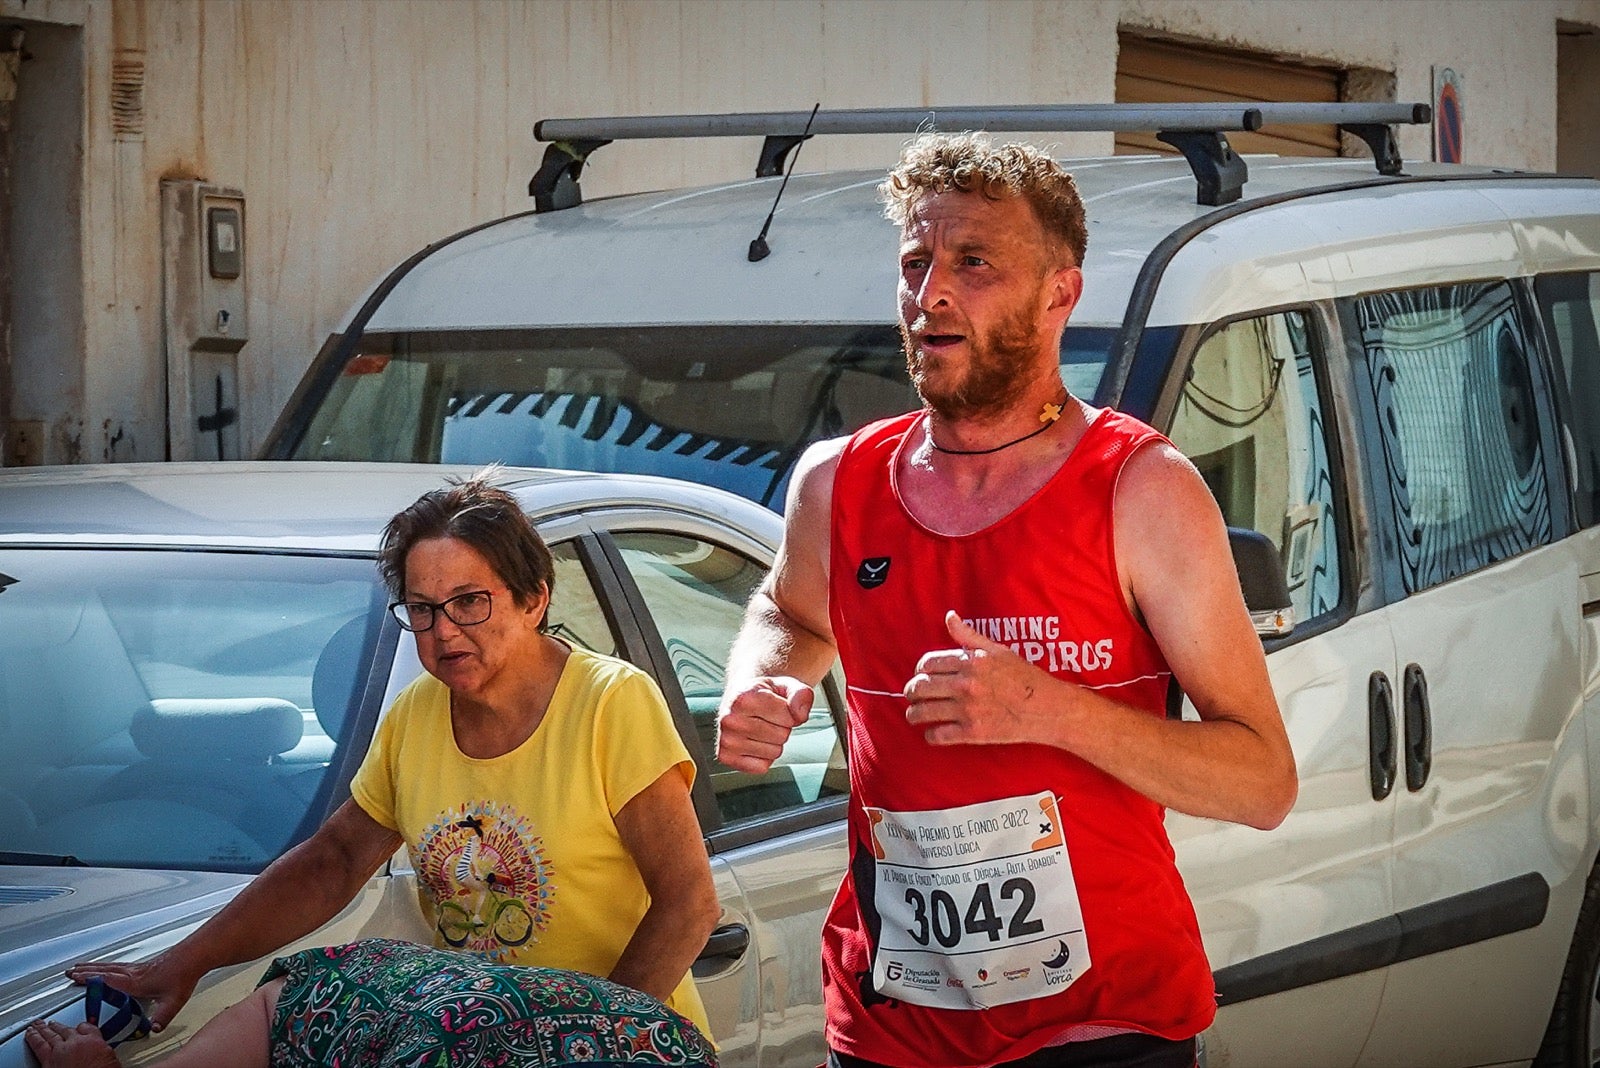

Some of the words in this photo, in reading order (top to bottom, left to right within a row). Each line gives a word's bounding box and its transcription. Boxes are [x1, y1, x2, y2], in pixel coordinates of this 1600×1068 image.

[1007, 638, 1113, 673] PIROS
[919, 825, 951, 842] PREMIO
[953, 825, 965, 839] DE
[968, 817, 999, 836] FONDO
[1000, 808, 1030, 829] 2022
[954, 840, 981, 856] LORCA
[962, 871, 972, 884] DE
[1006, 862, 1026, 876] RUTA
[904, 876, 1045, 949] 3042
